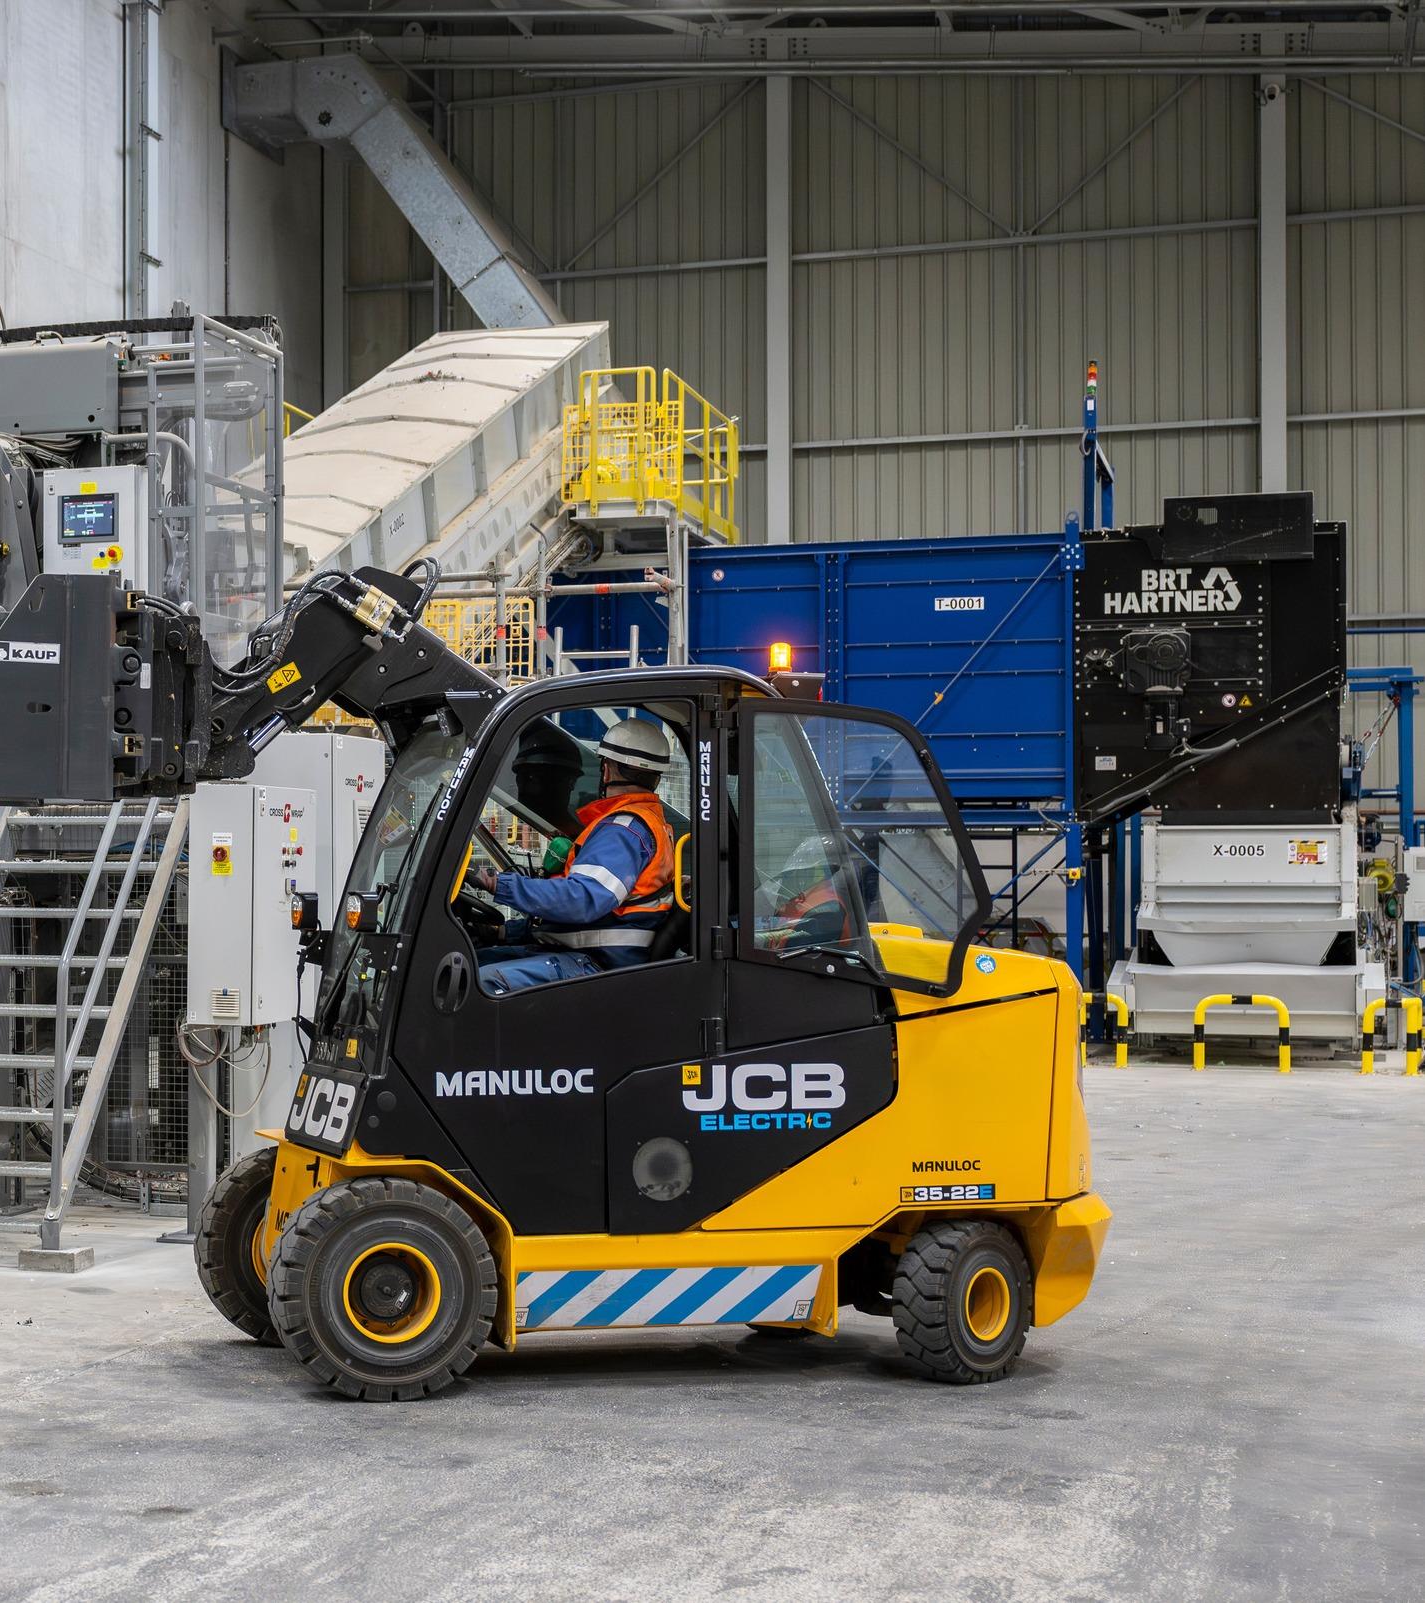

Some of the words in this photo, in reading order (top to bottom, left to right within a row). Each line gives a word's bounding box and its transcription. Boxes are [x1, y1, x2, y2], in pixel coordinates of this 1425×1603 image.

[1141, 568, 1193, 591] BRT
[936, 598, 982, 610] T-0001
[1104, 589, 1226, 614] HARTNER
[12, 649, 57, 660] KAUP
[436, 746, 477, 821] MANULOC
[699, 741, 712, 822] MANULOC
[269, 807, 284, 817] CROSS
[1213, 845, 1265, 857] X-0005
[435, 1068, 594, 1097] MANULOC
[682, 1063, 846, 1111] JCB
[289, 1076, 356, 1143] JCB
[912, 1160, 981, 1173] MANULOC
[914, 1185, 993, 1201] 35-22E
